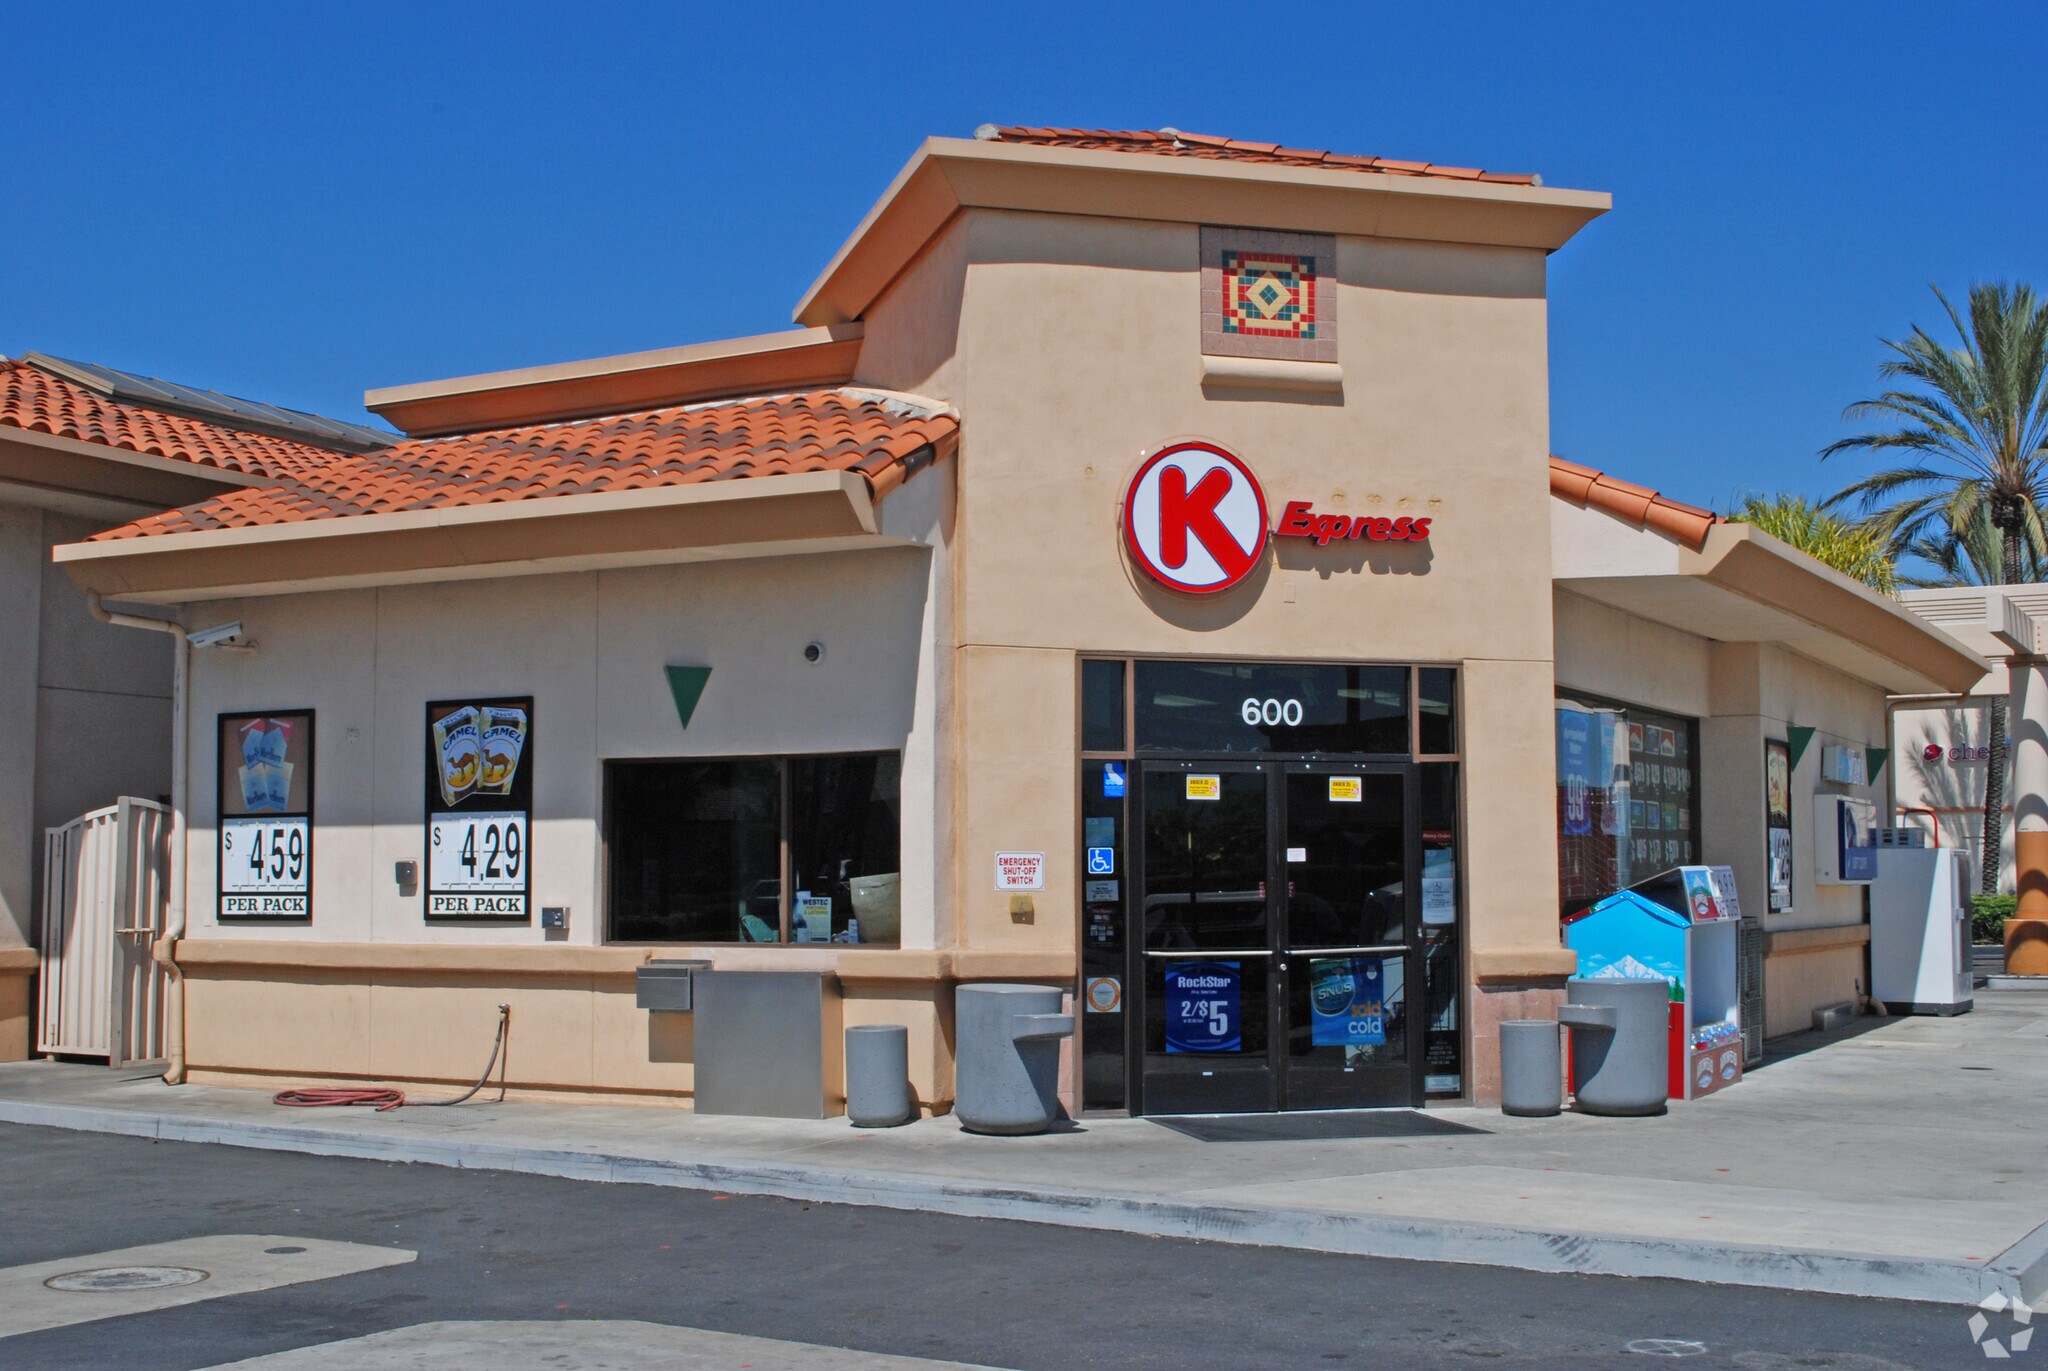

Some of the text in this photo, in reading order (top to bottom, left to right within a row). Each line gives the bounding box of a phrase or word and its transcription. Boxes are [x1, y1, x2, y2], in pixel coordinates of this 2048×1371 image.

[1157, 463, 1253, 580] K
[1276, 500, 1433, 546] Express
[1241, 698, 1303, 727] 600
[443, 726, 478, 751] CAMEL
[482, 727, 522, 744] CAMEL
[225, 828, 303, 883] $ 4.59
[433, 822, 521, 881] $ 4.29
[999, 857, 1041, 866] EMERGENCY
[1003, 867, 1037, 875] SHUT-OFF
[1007, 876, 1034, 884] SWITCH
[227, 898, 305, 911] PER PACK
[434, 897, 522, 912] PER PACK
[1178, 976, 1231, 988] RockStar
[1318, 983, 1353, 1000] SNUS
[1351, 1000, 1382, 1018] sold
[1348, 1016, 1382, 1035] cold
